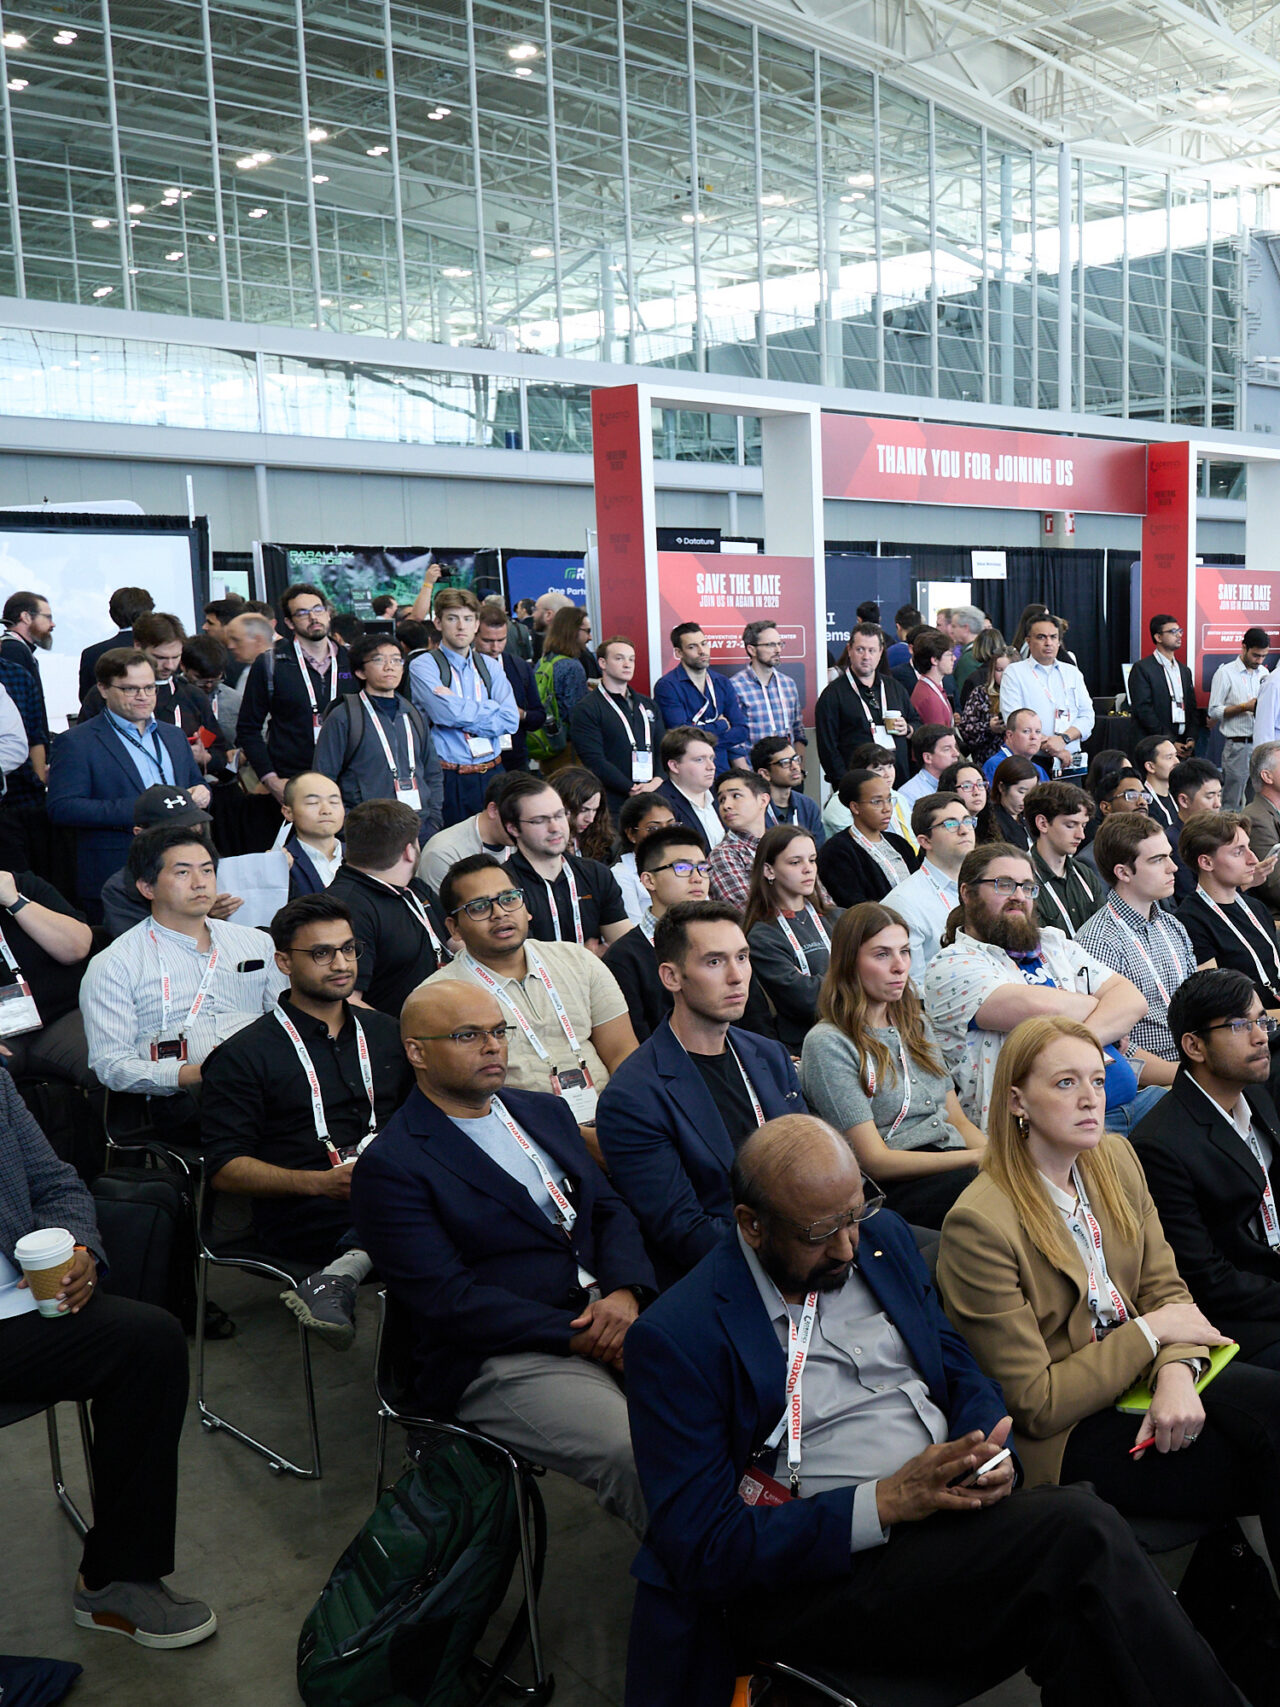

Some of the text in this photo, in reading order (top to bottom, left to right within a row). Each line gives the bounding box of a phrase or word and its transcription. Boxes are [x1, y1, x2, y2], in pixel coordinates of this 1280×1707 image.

[877, 444, 1073, 486] THANK YOU FOR JOINING US
[684, 537, 715, 545] Datature
[290, 557, 343, 565] WORLDS
[566, 587, 586, 596] Part
[696, 573, 781, 595] SAVE THE DATE
[1218, 584, 1271, 601] SAVE THE DATE
[699, 595, 715, 607] JOIN
[716, 595, 725, 608] US
[727, 595, 734, 608] IN
[735, 595, 754, 608] AGAIN
[755, 596, 763, 608] IN
[825, 631, 851, 642] ems
[789, 932, 800, 951] maxon
[475, 966, 495, 986] maxon
[538, 967, 552, 989] maxon
[191, 993, 204, 1015] maxon
[512, 1007, 530, 1032] maxon
[560, 1014, 574, 1039] maxon
[283, 1021, 300, 1043] maxon
[359, 1036, 367, 1060] maxon
[309, 1070, 320, 1098] maxon
[507, 1121, 530, 1150] maxon
[546, 1181, 568, 1210] maxon
[1086, 1213, 1101, 1249] maxon
[787, 1350, 804, 1395] maxon
[792, 1393, 801, 1440] maxon
